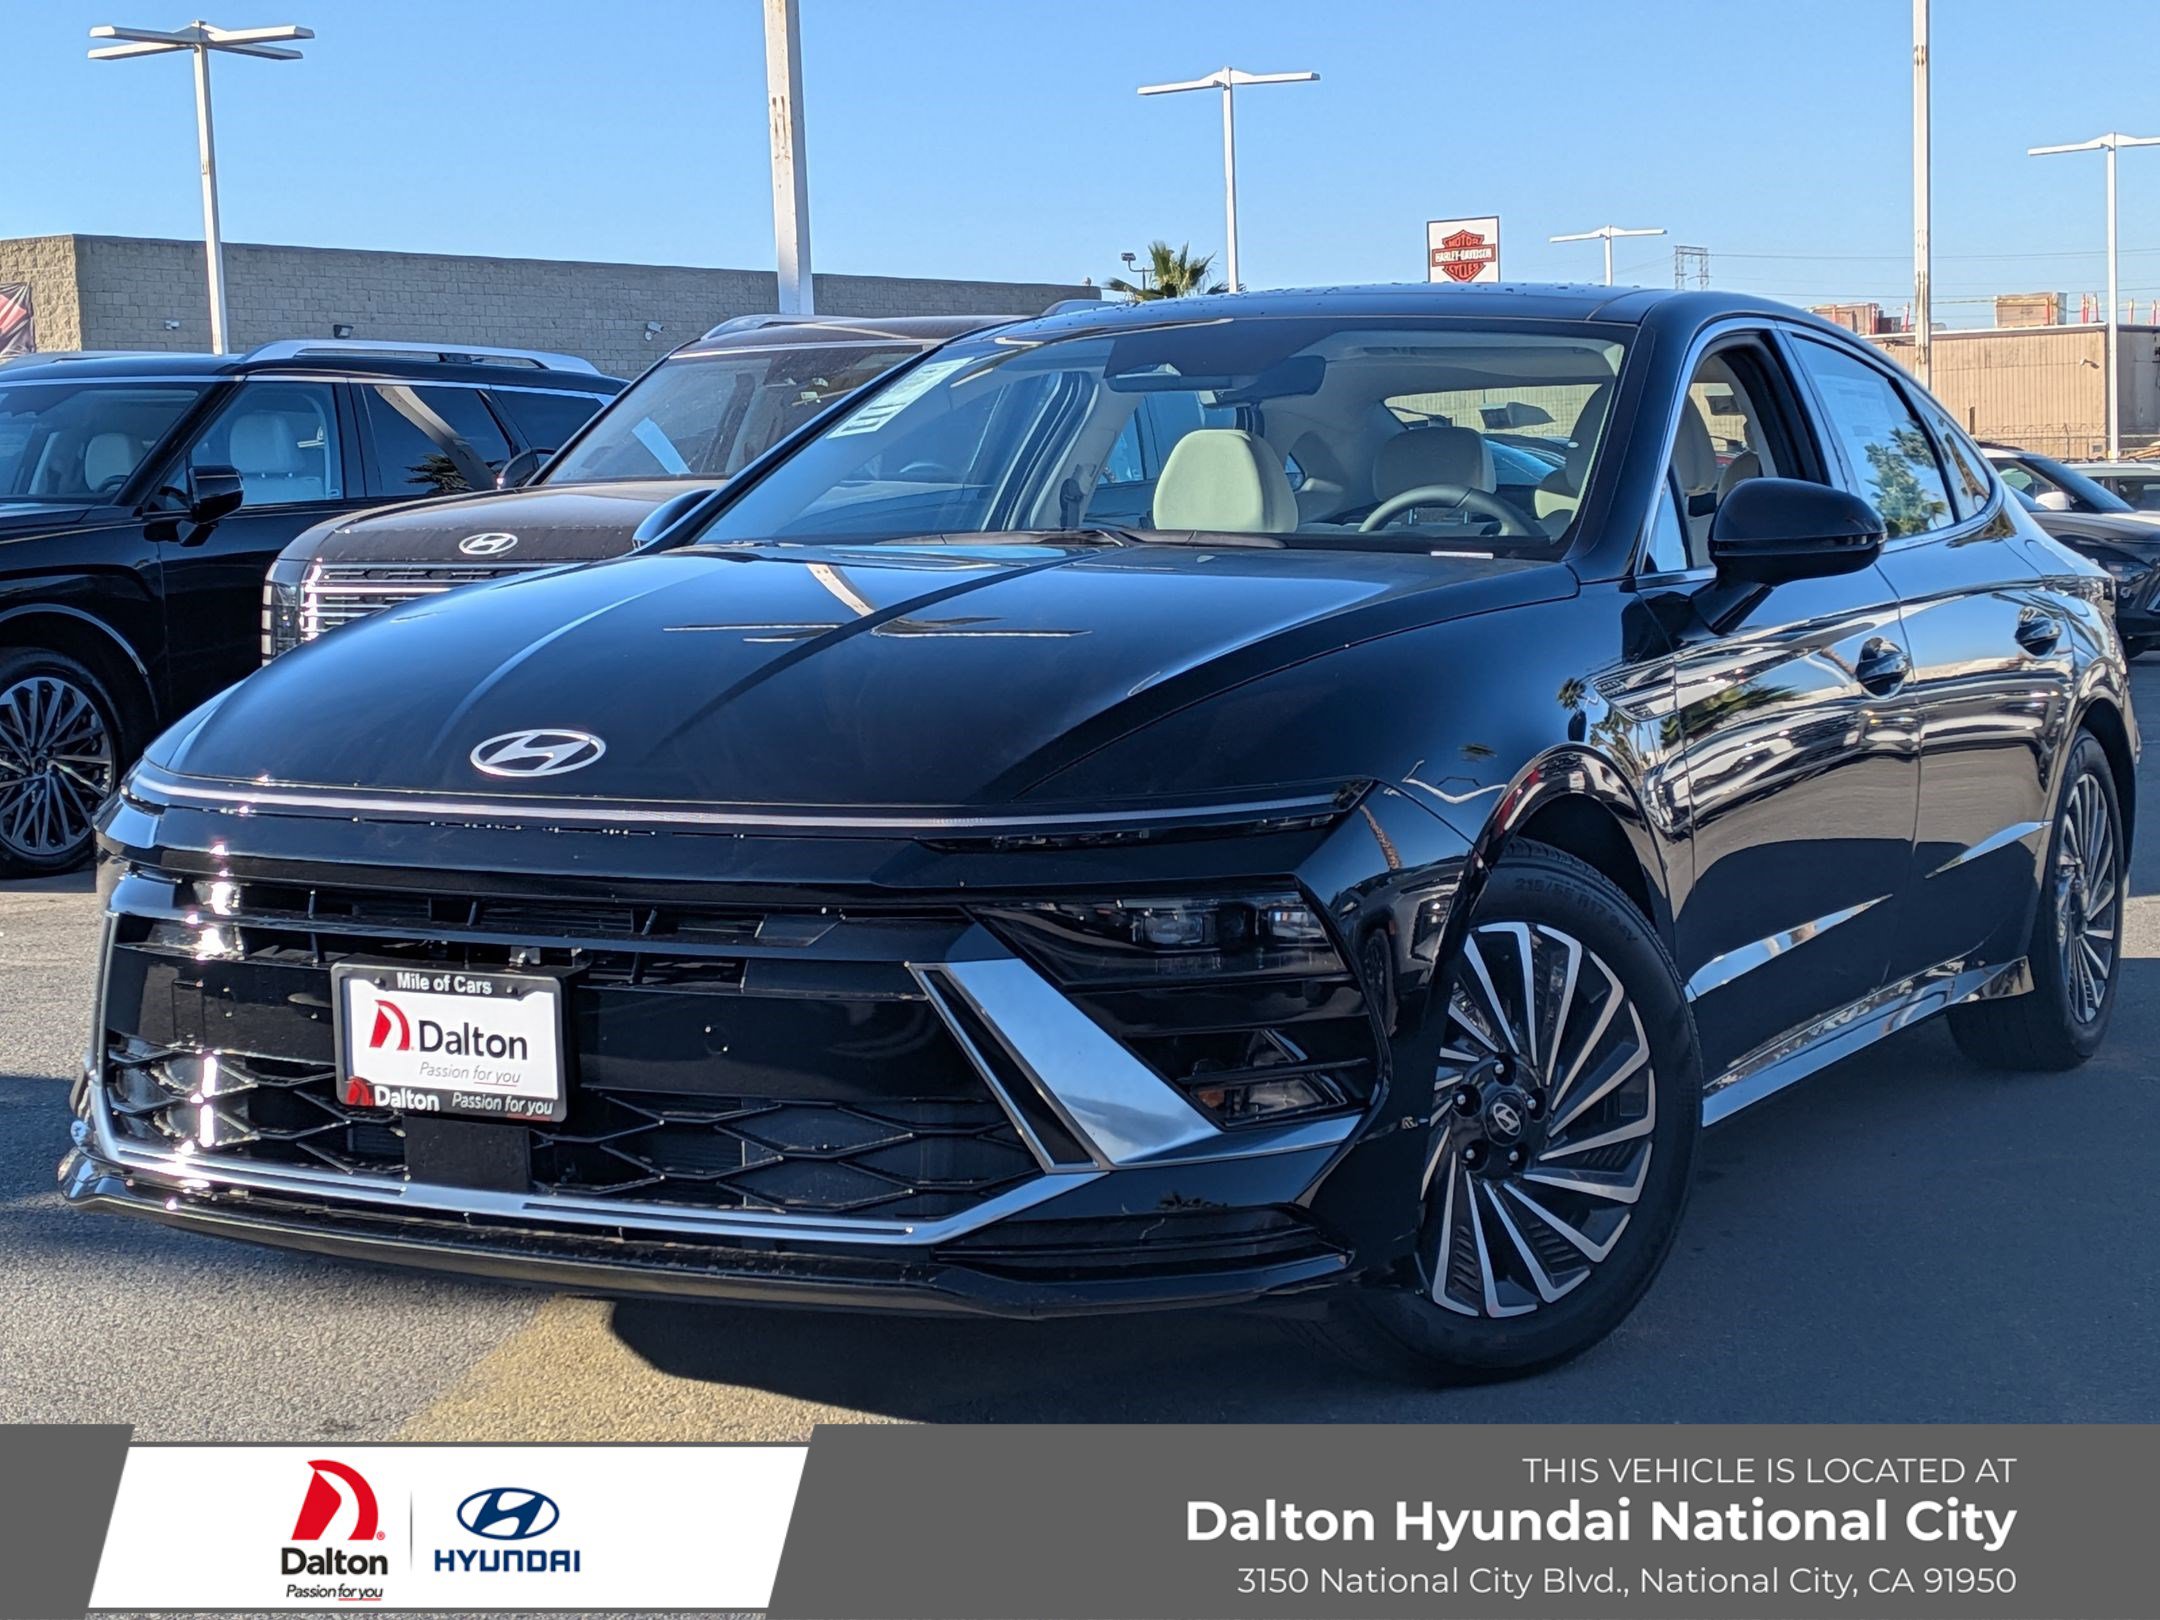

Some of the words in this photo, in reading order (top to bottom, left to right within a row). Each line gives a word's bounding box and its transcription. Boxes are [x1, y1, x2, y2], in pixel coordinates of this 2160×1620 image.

[1448, 234, 1479, 247] MOTOR
[1448, 263, 1479, 278] CYCLES
[396, 972, 430, 991] Mile
[433, 976, 451, 992] of
[454, 976, 493, 995] Cars
[418, 1019, 528, 1061] Dalton
[419, 1061, 470, 1080] Passion
[472, 1067, 492, 1083] for
[495, 1071, 521, 1084] you
[374, 1086, 440, 1111] Dalton
[452, 1091, 501, 1111] Passion
[504, 1097, 523, 1113] for
[525, 1101, 553, 1116] you
